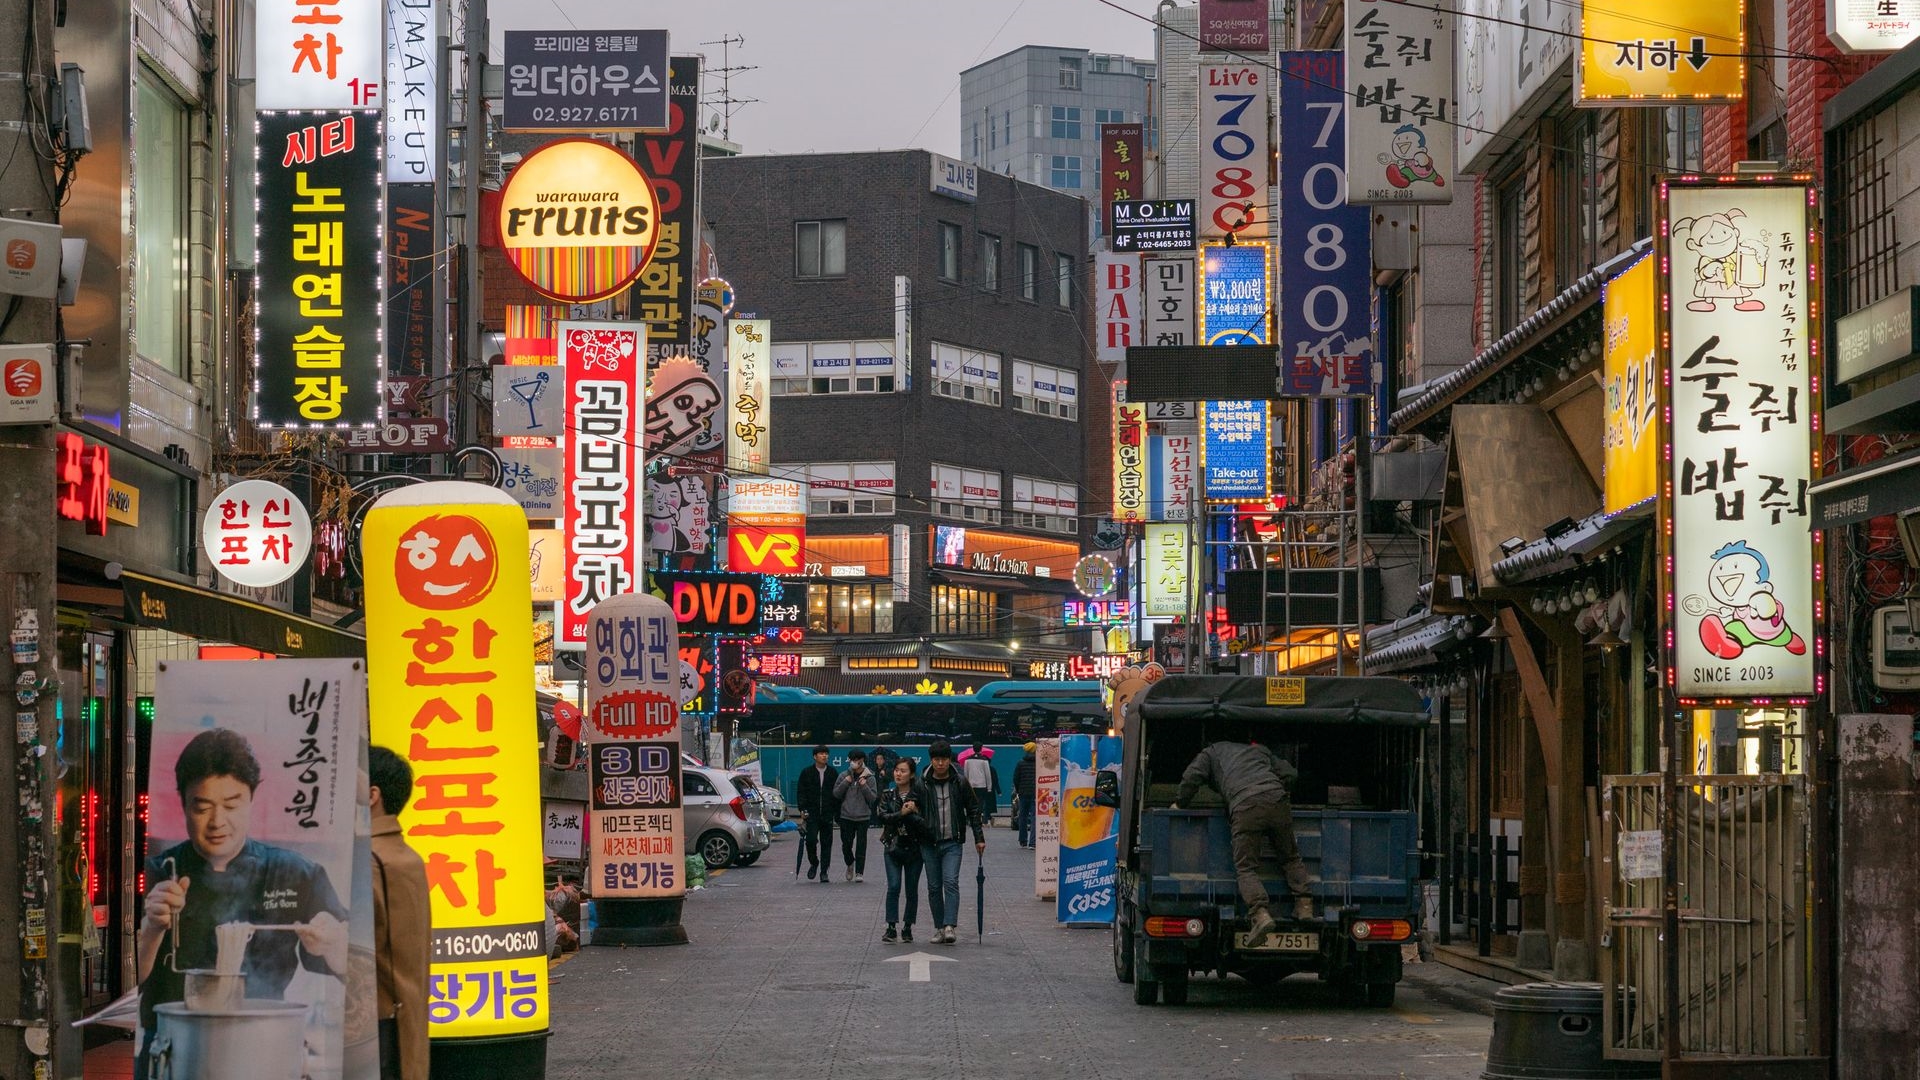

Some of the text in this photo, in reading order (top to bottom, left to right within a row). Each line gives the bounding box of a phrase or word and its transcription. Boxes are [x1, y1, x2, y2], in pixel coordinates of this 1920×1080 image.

[534, 36, 638, 52] 프리미엄 원룸텔
[1204, 33, 1264, 46] T.921-2167
[1615, 39, 1680, 72] 지하
[509, 64, 661, 97] 원더하우스
[1208, 68, 1259, 87] Live
[346, 78, 378, 106] 1F
[532, 106, 638, 123] 02.927.6171
[282, 116, 354, 168] 시티
[946, 162, 975, 191] 고시원
[536, 191, 619, 203] warawara
[1367, 189, 1414, 199] SINCE 2003
[1115, 235, 1131, 247] 4F
[1136, 240, 1192, 249] T.02-6465-2033
[291, 172, 348, 420] 노래연습장
[1106, 263, 1131, 348] BAR
[1155, 400, 1187, 417] 2층
[348, 423, 438, 447] HOF
[1118, 406, 1143, 509] 노래연습장
[1211, 467, 1259, 478] Take-out
[734, 483, 801, 498] 피부관리샵
[219, 498, 292, 530] 한신
[219, 533, 294, 565] 포차
[735, 533, 801, 568] VR
[672, 582, 757, 625] DVD
[1064, 601, 1130, 626] 라이브
[596, 616, 670, 686] 영화관
[1693, 665, 1775, 683] SINCE 2003
[600, 702, 673, 727] Full HD
[282, 677, 328, 829] 백종원
[403, 616, 509, 917] 한신포차
[603, 776, 670, 804] 진동의자
[602, 814, 673, 834] HD프로젝터
[602, 836, 673, 857] 새것전체교체
[604, 862, 674, 890] 흡연가능
[1275, 934, 1311, 949] 7551
